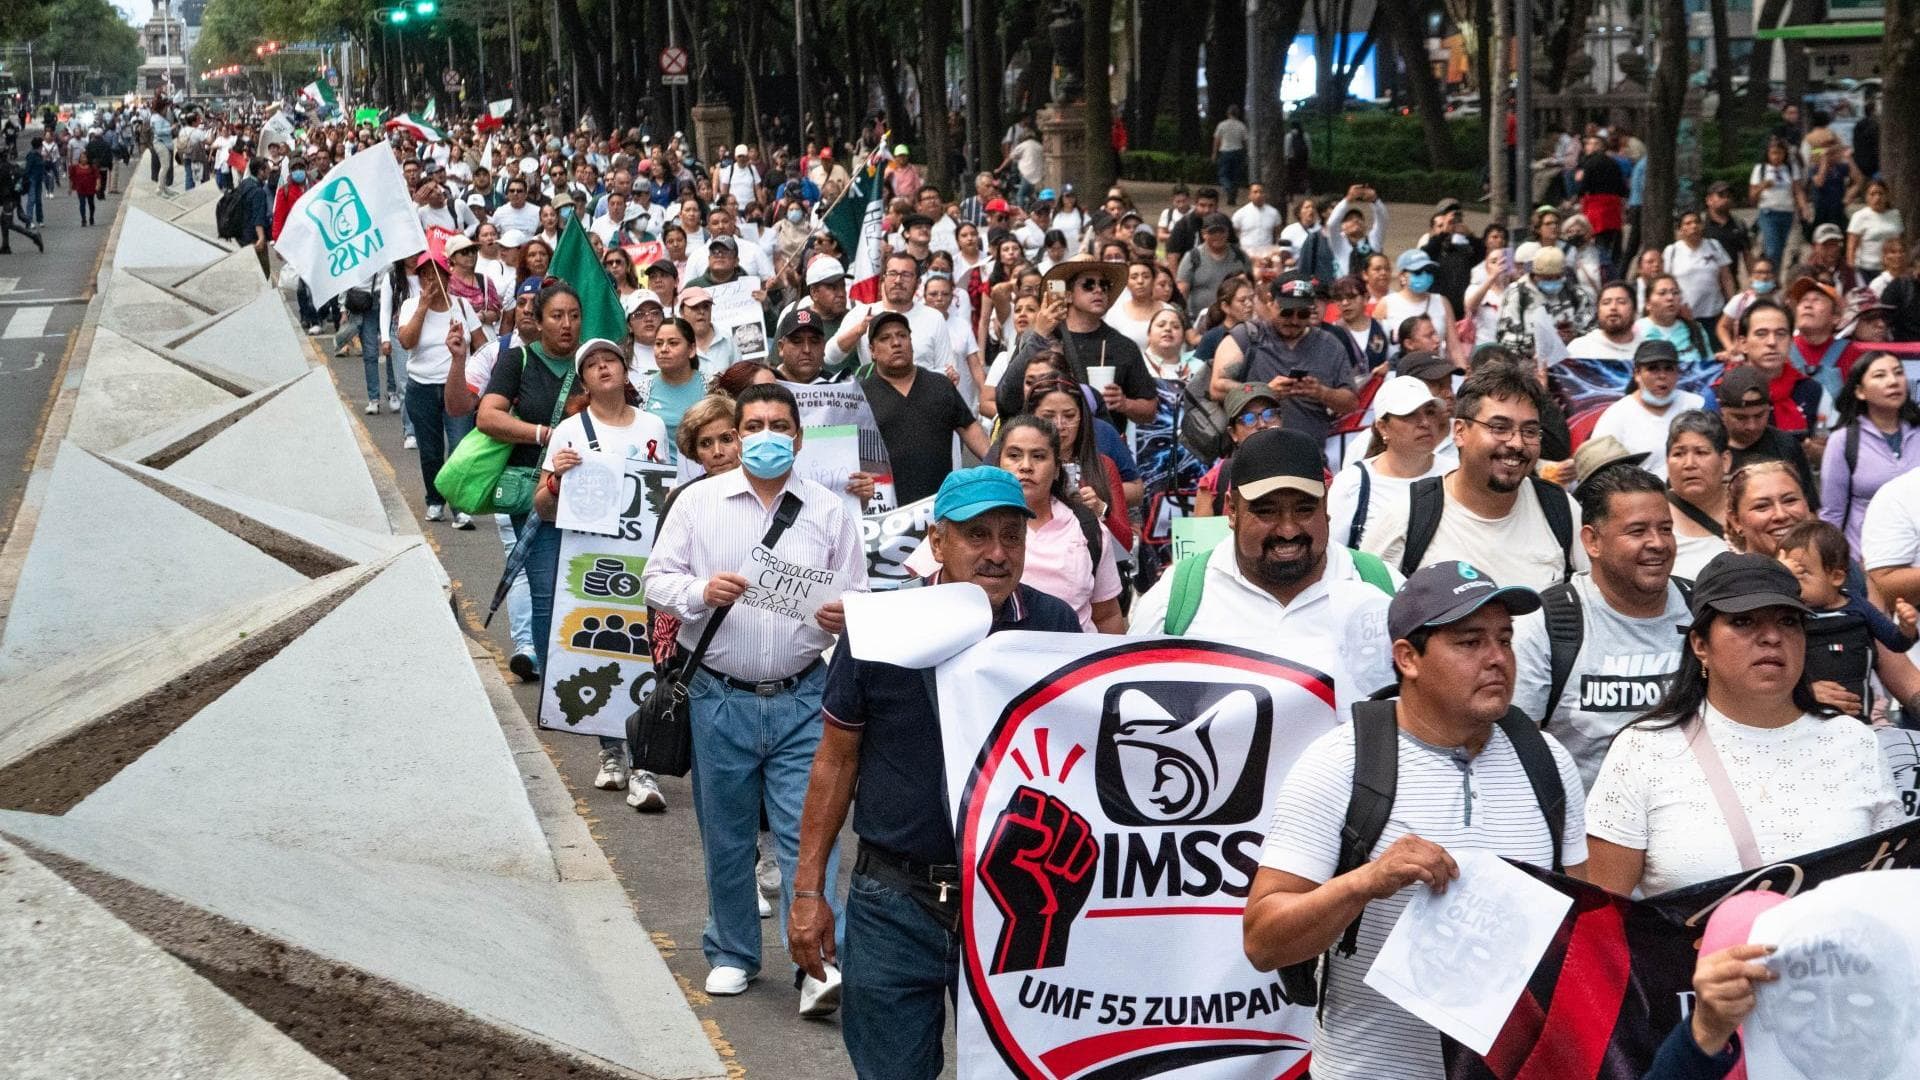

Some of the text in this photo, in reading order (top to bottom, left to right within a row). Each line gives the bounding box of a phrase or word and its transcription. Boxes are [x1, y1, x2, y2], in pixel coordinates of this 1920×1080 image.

[796, 391, 835, 400] EDICINA
[807, 400, 824, 408] DEL
[751, 546, 834, 585] CARDIOLOGIA
[759, 569, 812, 599] CMN
[742, 598, 806, 621] NUTRICION
[1582, 681, 1630, 707] JUST
[1631, 681, 1662, 706] DO
[1102, 830, 1265, 899] IMSS
[1788, 952, 1873, 980] OLIVO
[1018, 975, 1294, 1026] UMF 55 ZUMPAN
